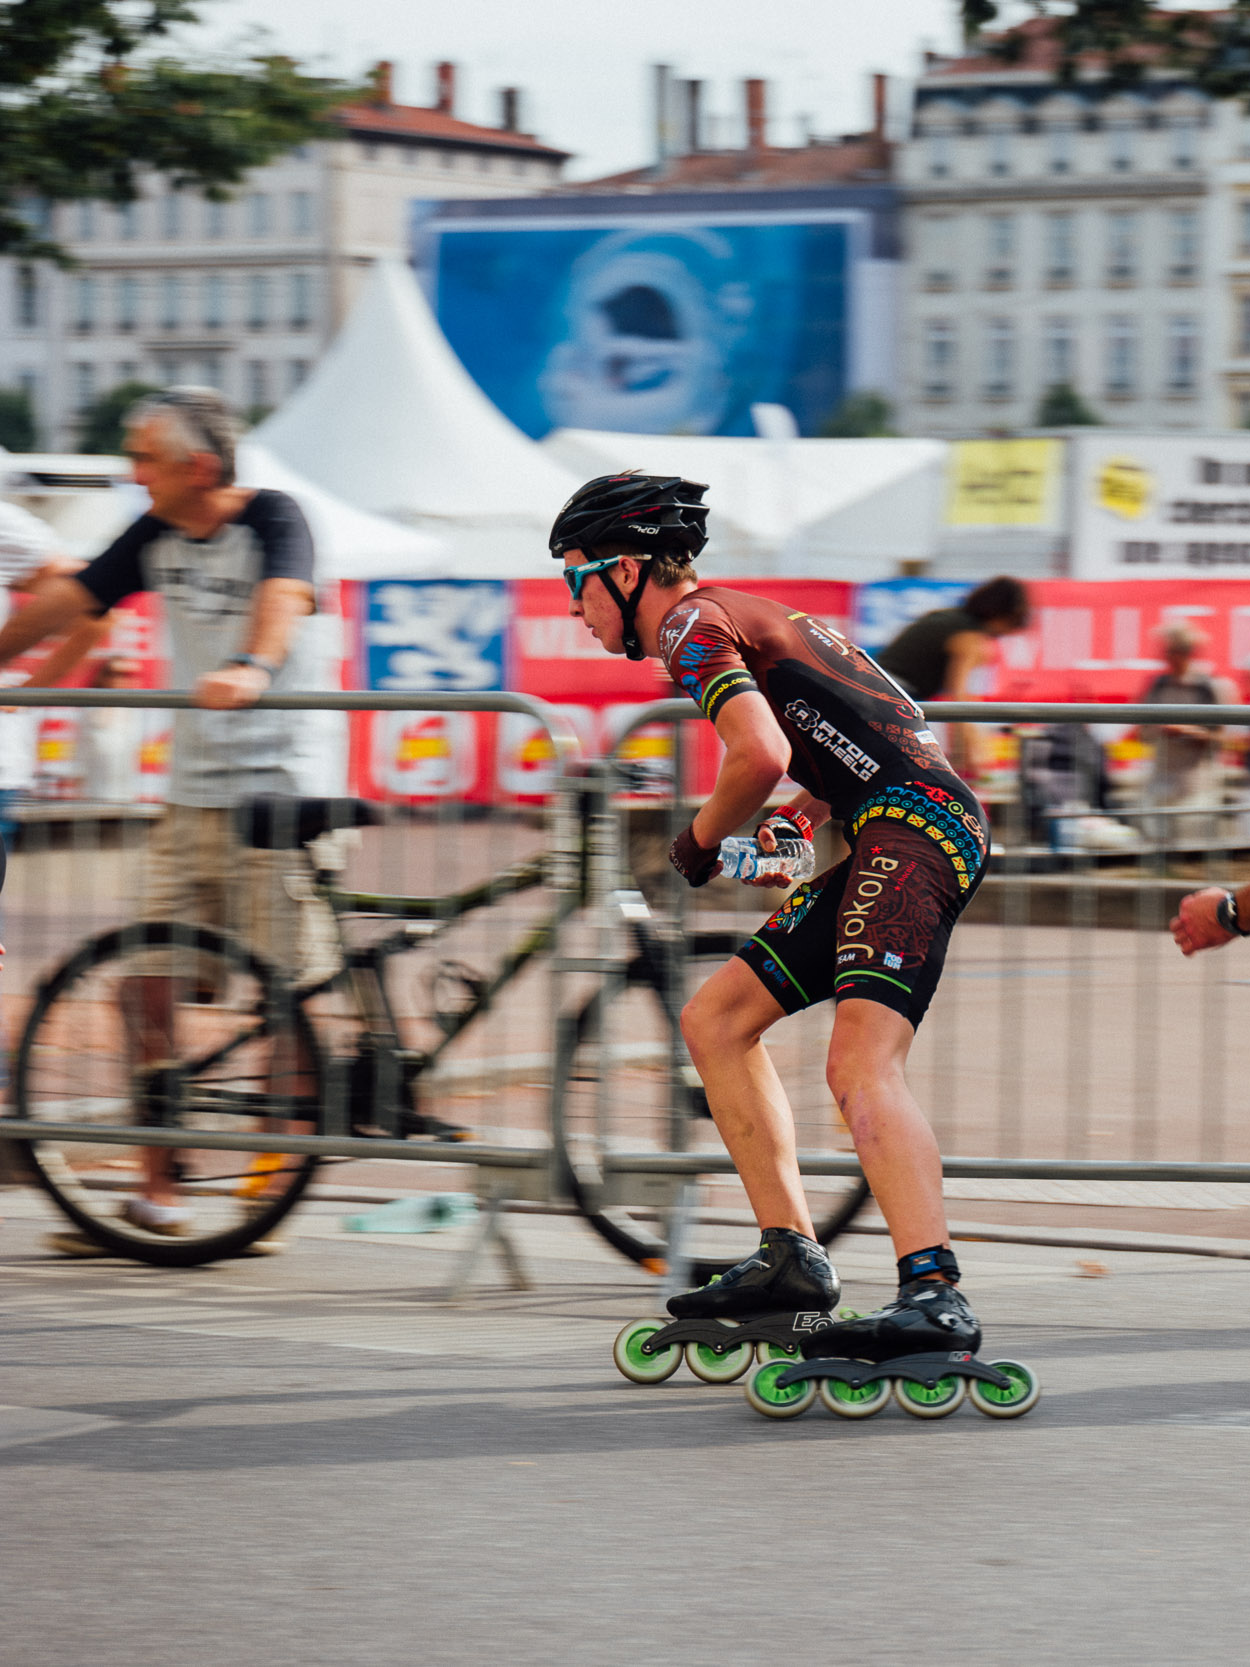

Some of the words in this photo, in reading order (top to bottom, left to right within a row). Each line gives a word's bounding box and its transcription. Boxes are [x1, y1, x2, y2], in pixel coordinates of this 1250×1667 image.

[811, 728, 873, 782] WHEELS
[817, 720, 881, 774] ATOM
[836, 855, 900, 960] Jokola
